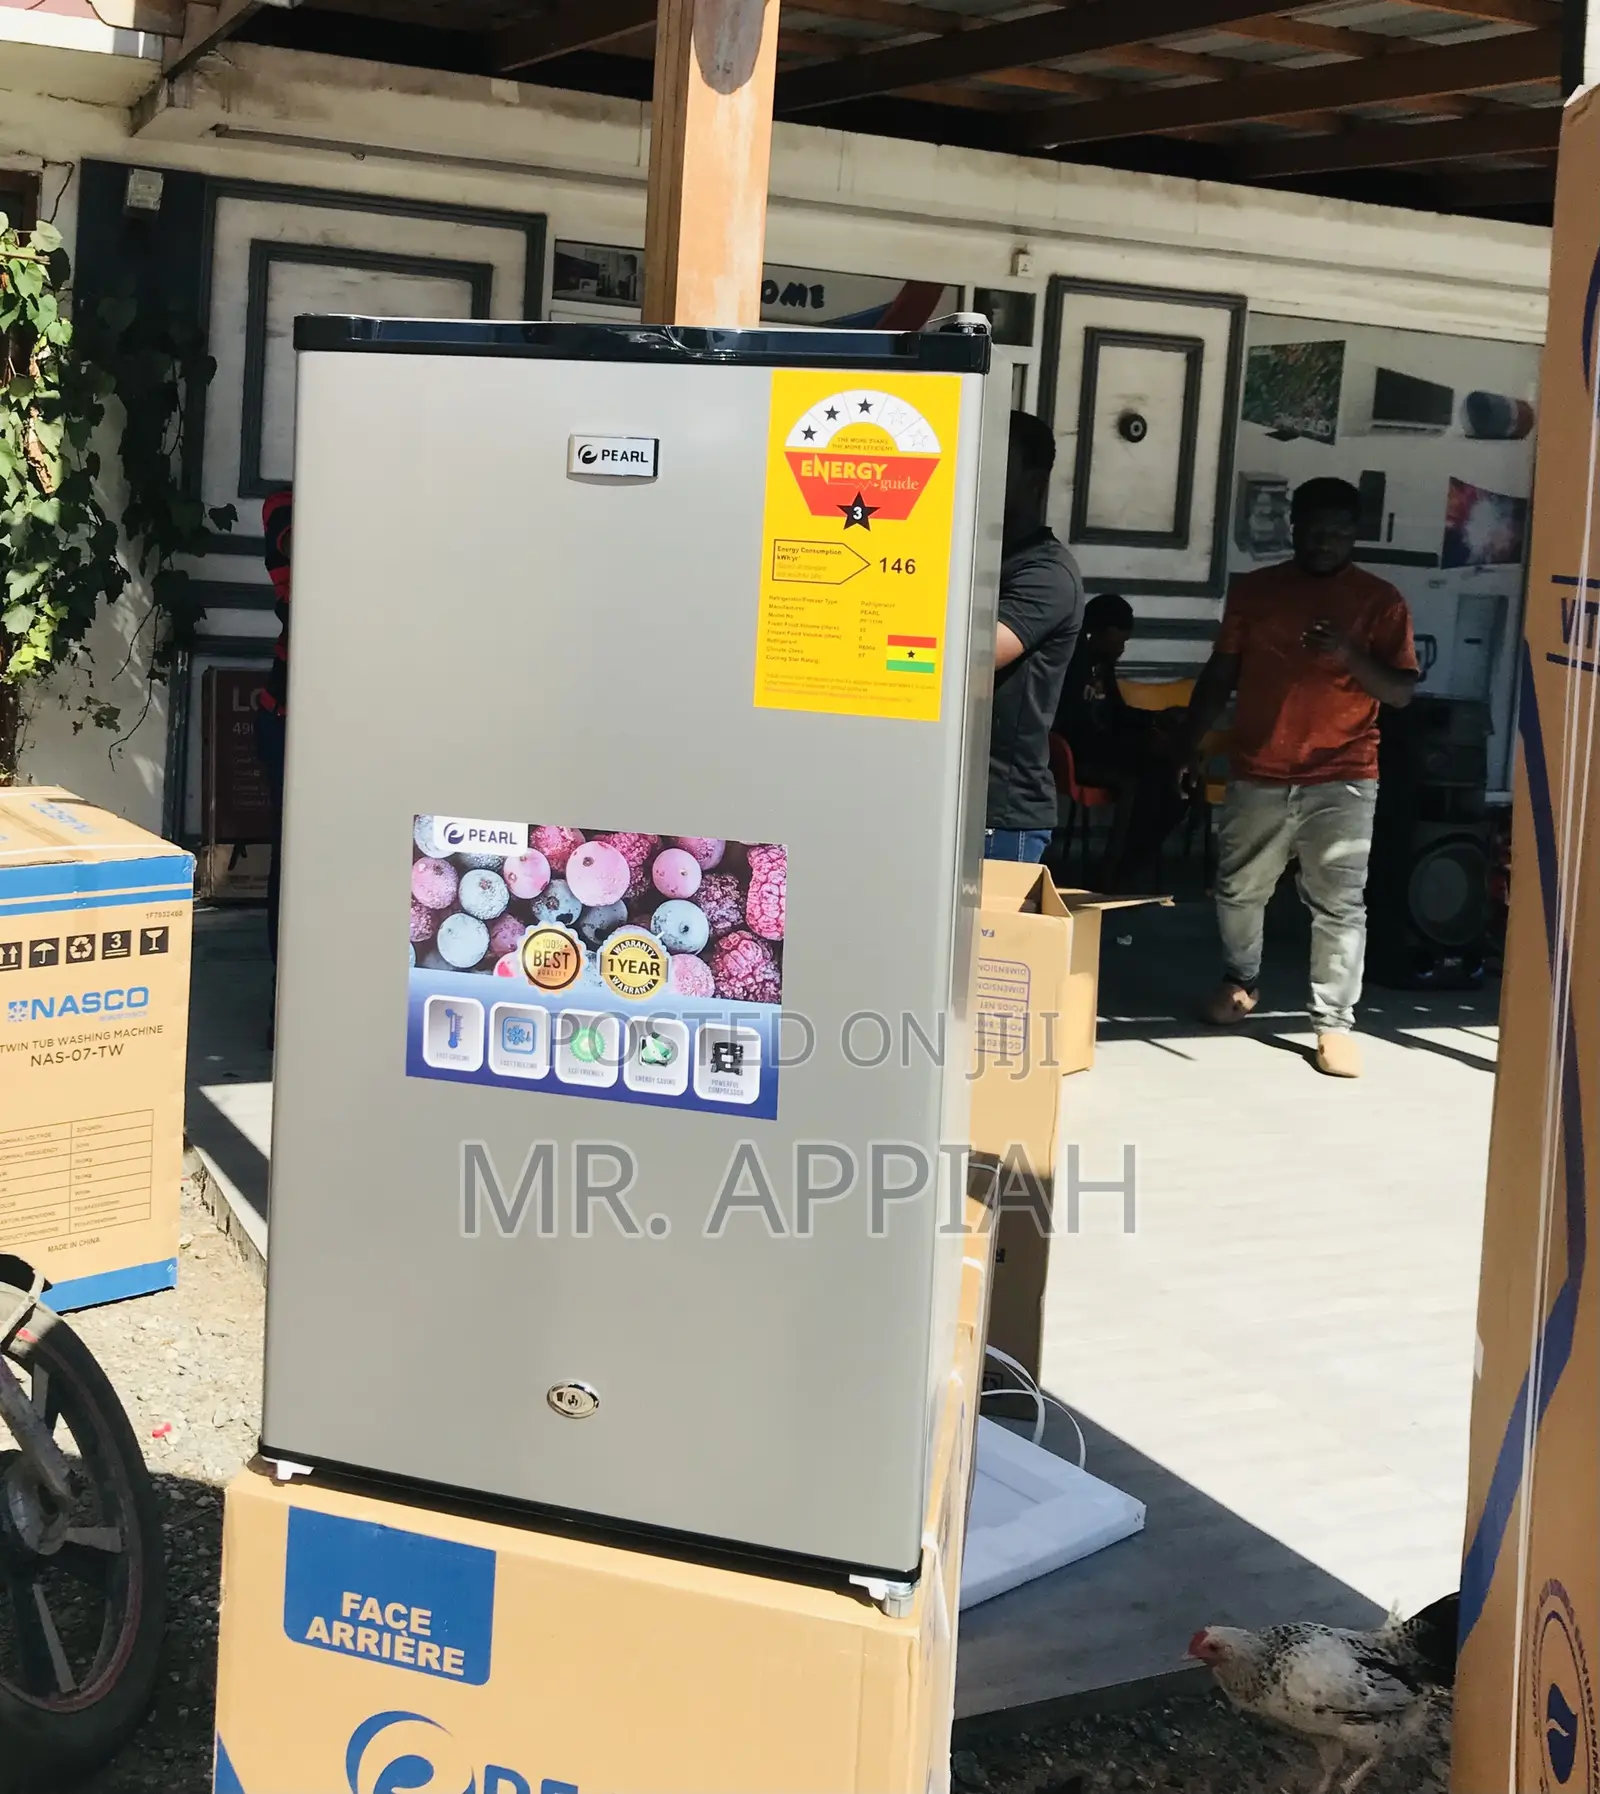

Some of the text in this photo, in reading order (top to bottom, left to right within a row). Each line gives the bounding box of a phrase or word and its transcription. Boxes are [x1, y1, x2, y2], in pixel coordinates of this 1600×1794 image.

[601, 449, 649, 463] PEARL
[801, 453, 888, 485] ENERGY
[880, 476, 920, 491] guide
[853, 506, 863, 520] 3
[777, 545, 842, 556] Energy Consumption
[879, 557, 916, 575] 146
[468, 827, 518, 845] PEARL
[542, 938, 564, 950] 100%
[613, 940, 657, 957] WARRANTY
[533, 950, 571, 970] BEST
[618, 959, 661, 977] YEAR
[537, 968, 567, 977] QUALITY
[612, 976, 655, 995] WARRANTY
[31, 986, 149, 1020] NASCO
[0, 1025, 164, 1053] TWIN TUB WASHING MACHINE
[30, 1043, 125, 1067] NAS-07-TW
[711, 1079, 739, 1088] POWERFUL
[48, 1244, 68, 1252] MADE
[79, 1236, 101, 1247] CHINA
[341, 1591, 432, 1636] FACE
[306, 1616, 465, 1676] ARRIÈRE
